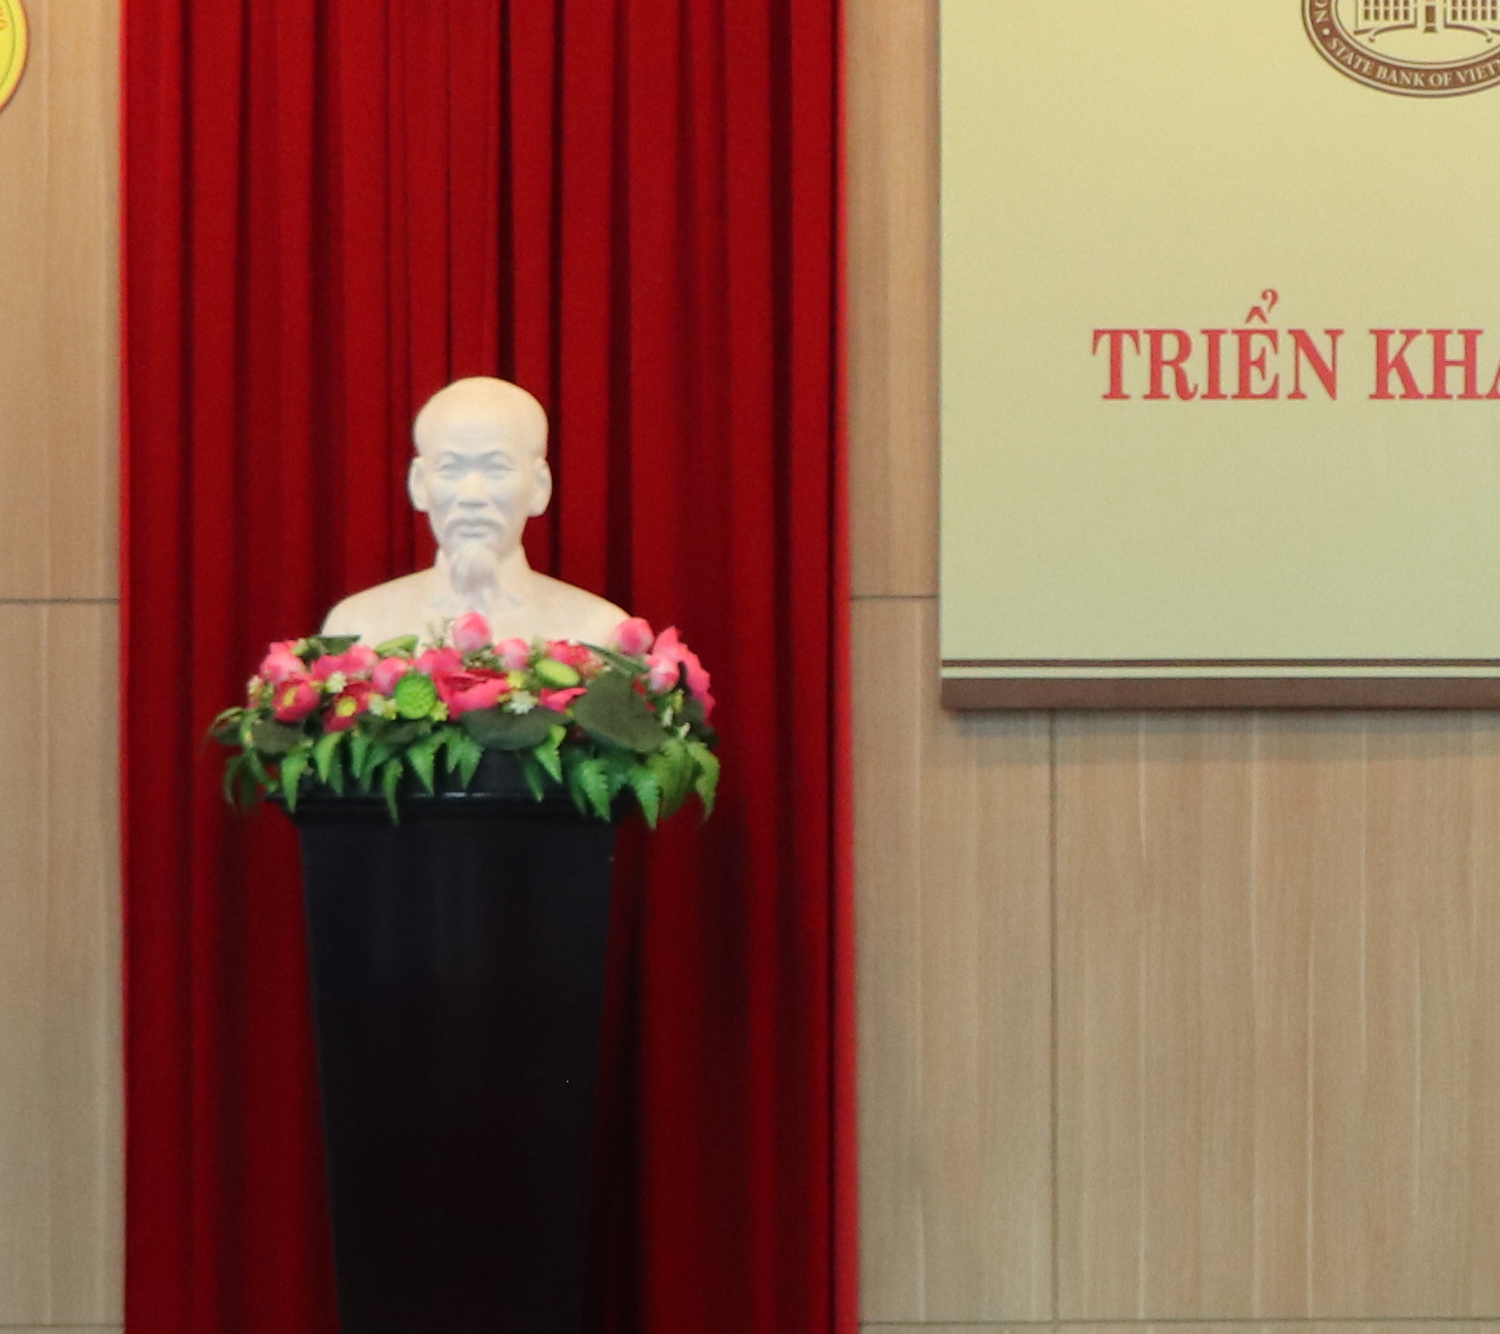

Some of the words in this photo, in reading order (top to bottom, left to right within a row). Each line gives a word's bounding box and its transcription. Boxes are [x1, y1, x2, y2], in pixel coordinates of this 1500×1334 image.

[1329, 37, 1374, 73] STATE
[1376, 66, 1425, 87] BANK
[1428, 72, 1451, 87] OF
[1092, 289, 1344, 401] TRIỂN
